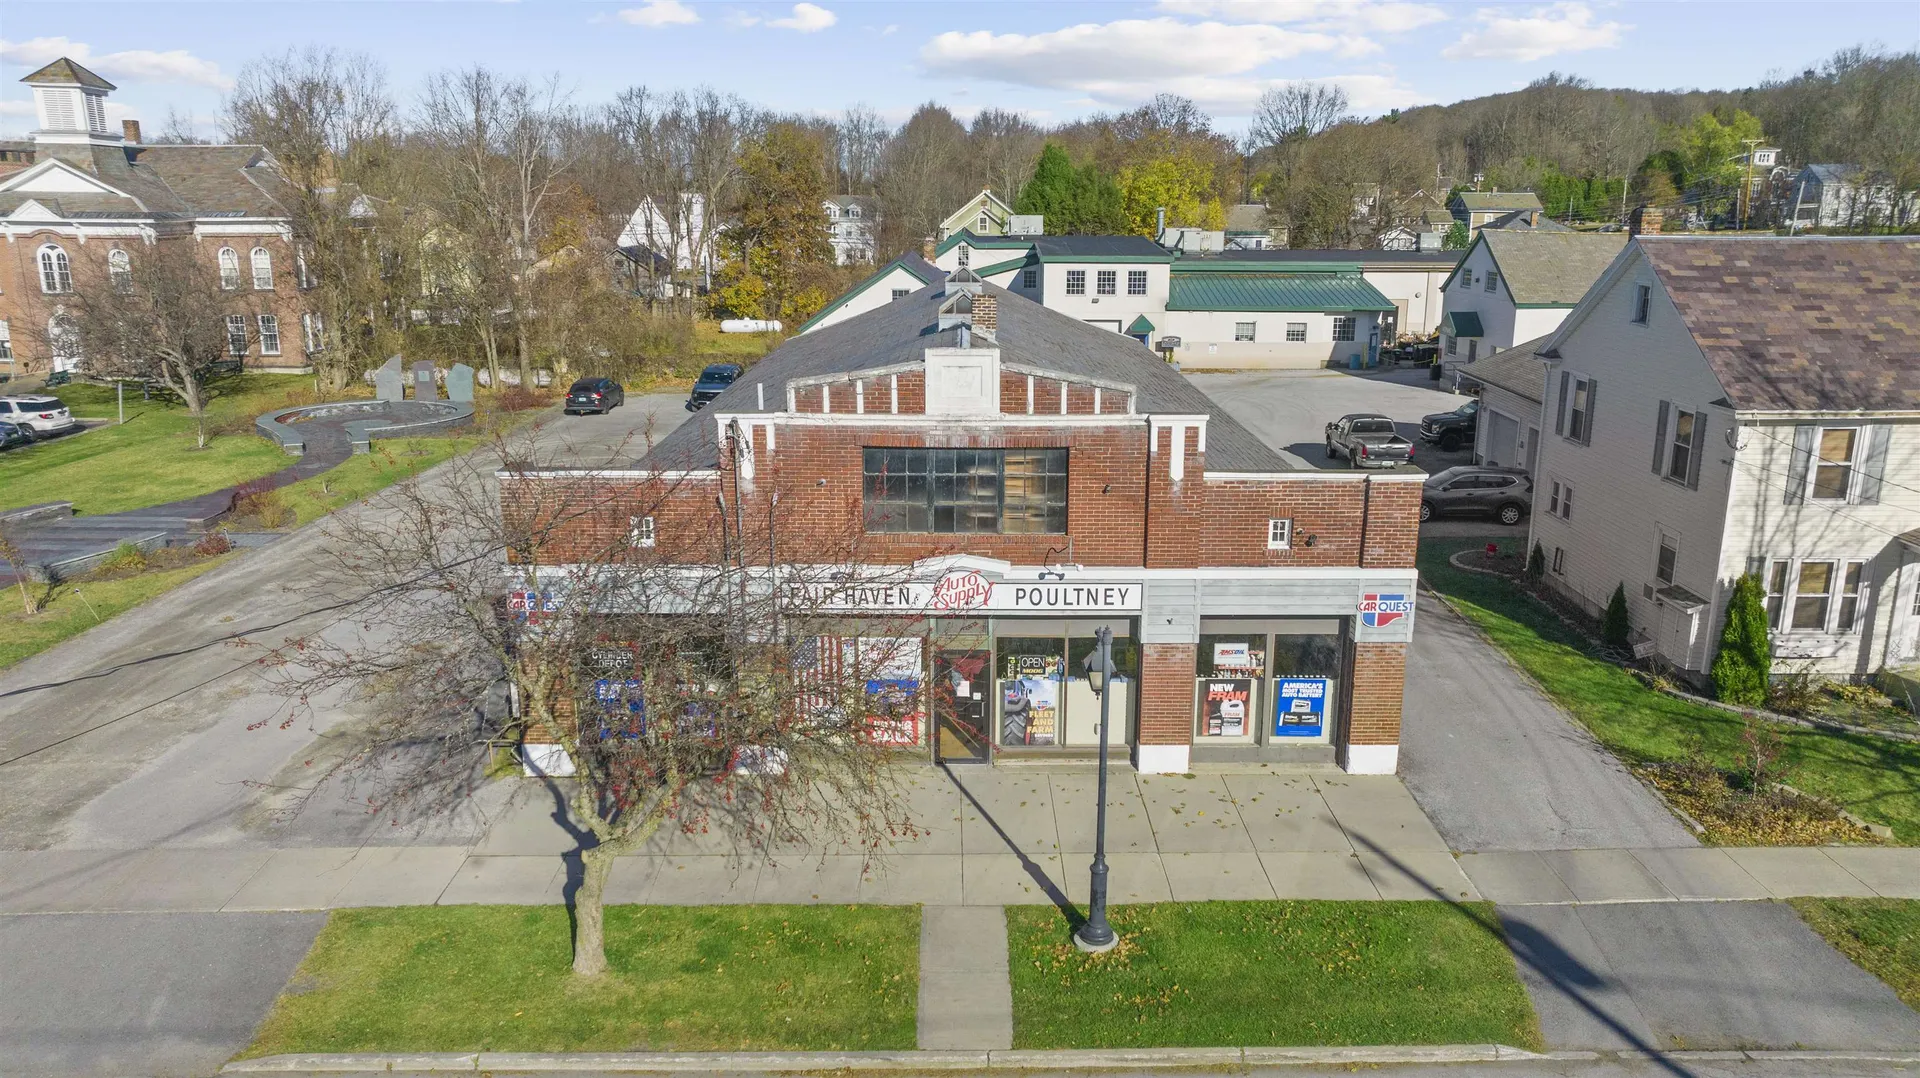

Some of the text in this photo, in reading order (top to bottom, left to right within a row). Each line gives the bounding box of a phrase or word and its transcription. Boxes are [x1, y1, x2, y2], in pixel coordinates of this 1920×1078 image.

[934, 570, 981, 597] AUTO
[845, 587, 910, 605] HAVEN
[934, 582, 996, 611] SUPPLY
[1015, 587, 1130, 607] POULTNEY
[1021, 657, 1045, 668] OPEN
[1209, 683, 1234, 692] NEW
[1207, 691, 1248, 701] FRAM
[1029, 710, 1054, 718] FLEET
[1032, 718, 1054, 726] AND
[1027, 725, 1054, 734] FARM
